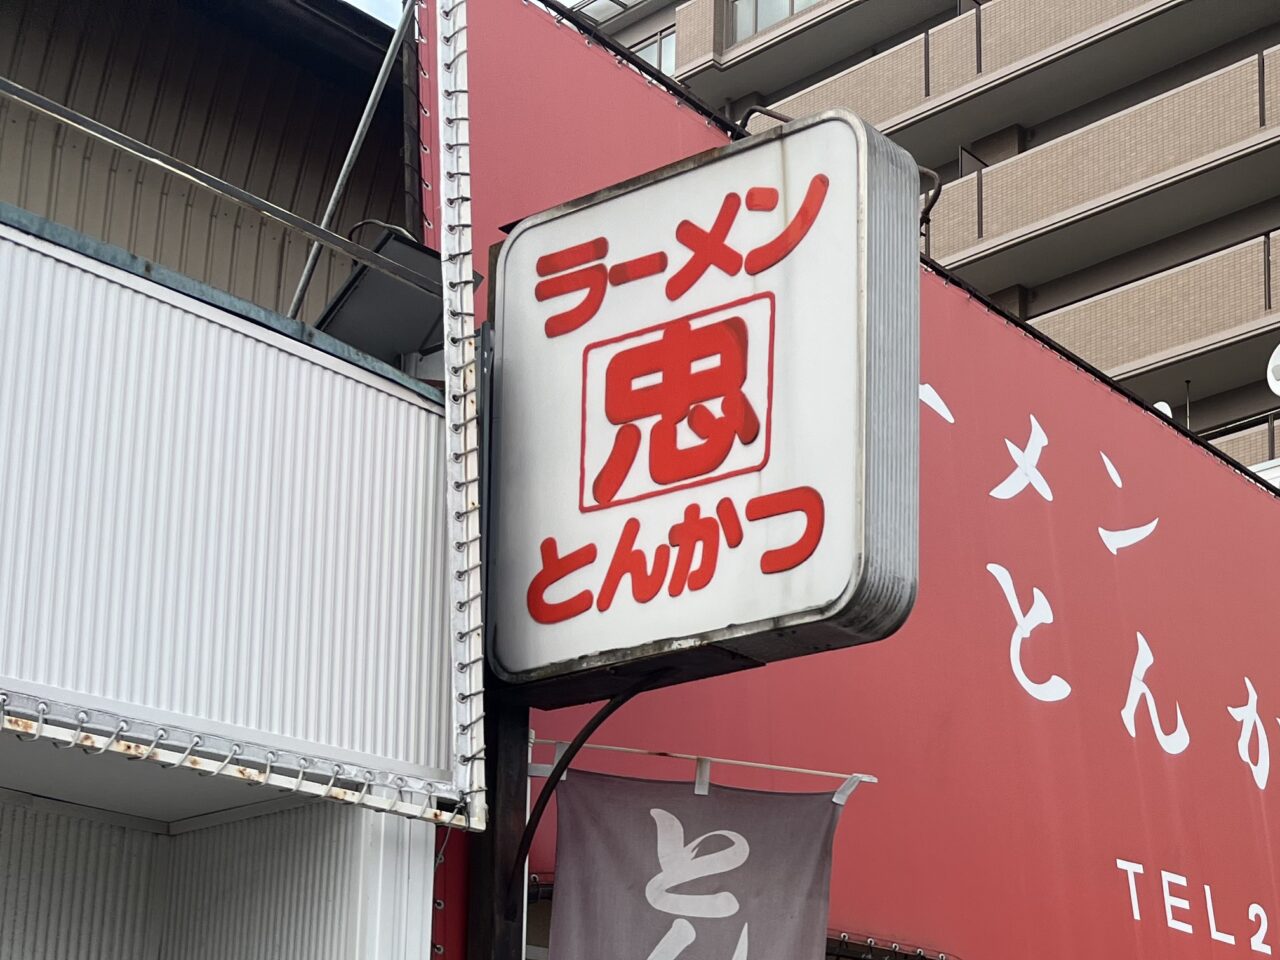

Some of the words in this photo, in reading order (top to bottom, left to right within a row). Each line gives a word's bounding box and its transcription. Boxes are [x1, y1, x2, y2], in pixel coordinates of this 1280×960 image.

[534, 173, 830, 338] ラーメン
[593, 316, 760, 504] 忠
[527, 486, 826, 624] とんかつ
